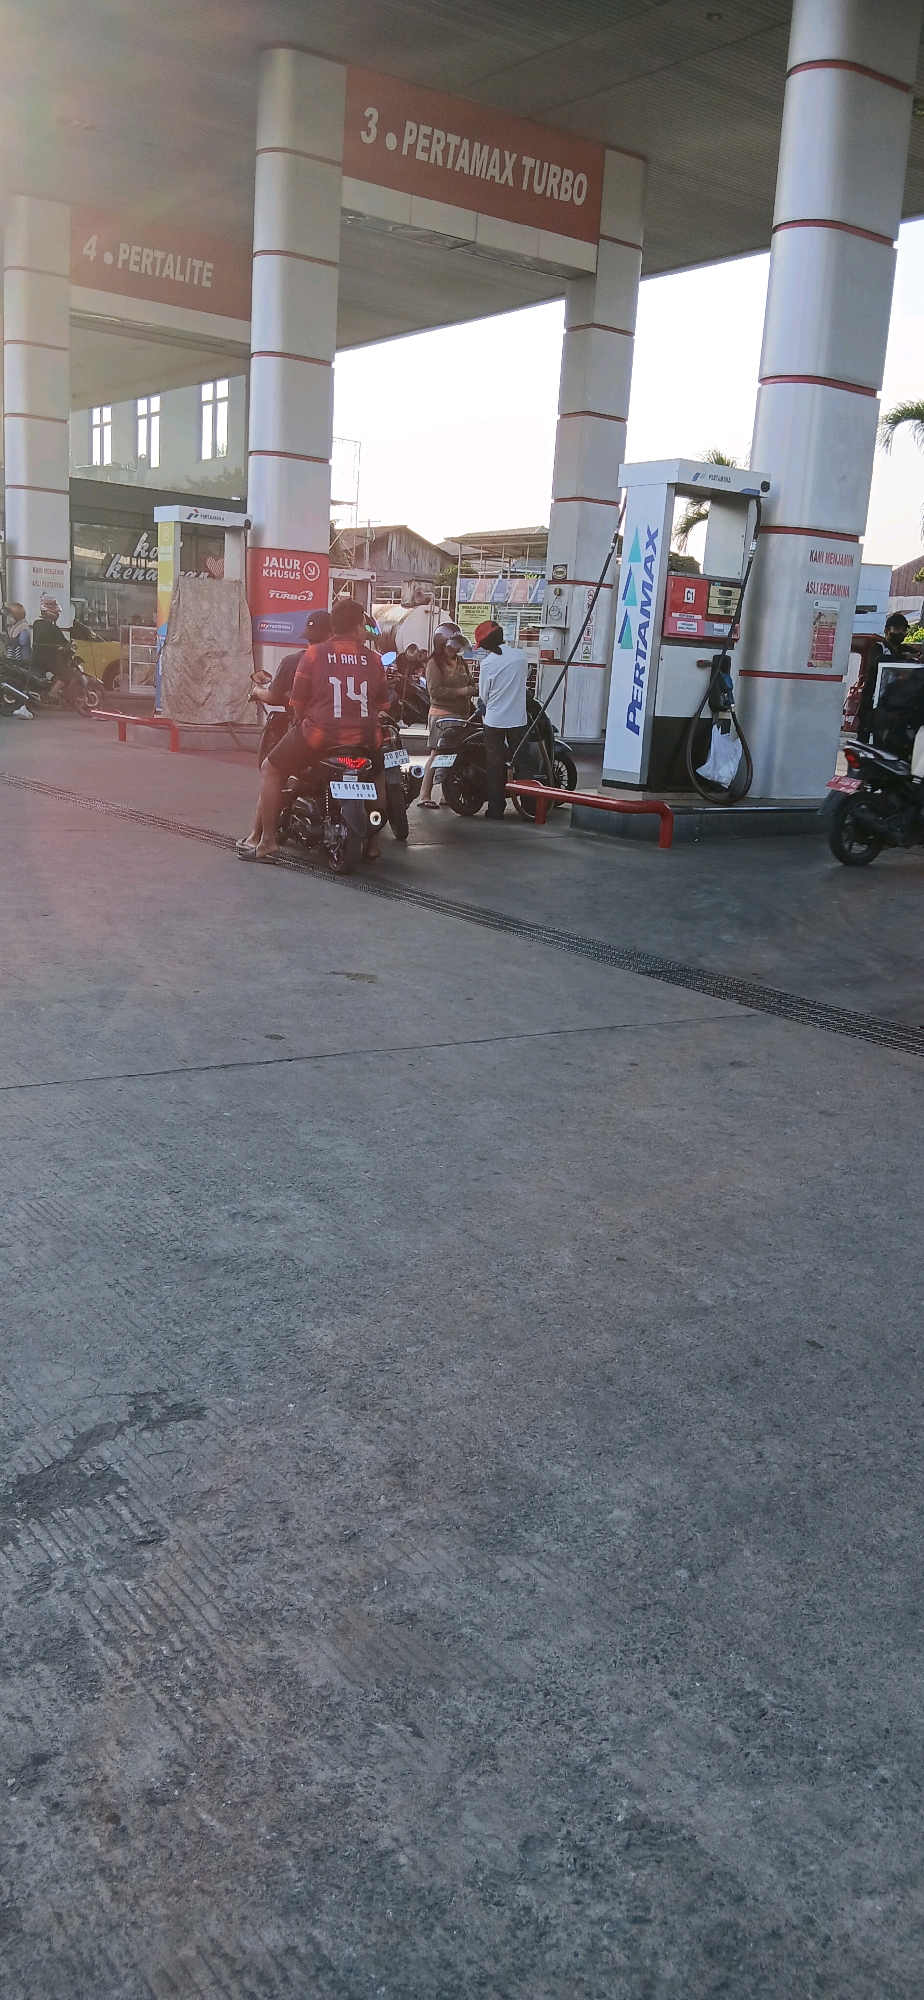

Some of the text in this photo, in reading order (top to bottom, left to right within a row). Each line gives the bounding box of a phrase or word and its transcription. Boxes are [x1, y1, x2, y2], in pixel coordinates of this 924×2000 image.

[401, 120, 518, 188] PERTAMAX
[521, 155, 588, 206] TURBO
[117, 242, 214, 288] PERTALITE
[262, 556, 300, 570] JALUR
[809, 549, 855, 568] KAMI MENJAMIN
[262, 568, 300, 580] KHUSUS
[270, 592, 306, 601] TURBO
[686, 590, 694, 601] C1
[805, 581, 850, 598] ASLI PERTAMINA
[625, 524, 659, 736] PERTAMAX
[328, 676, 369, 719] 14
